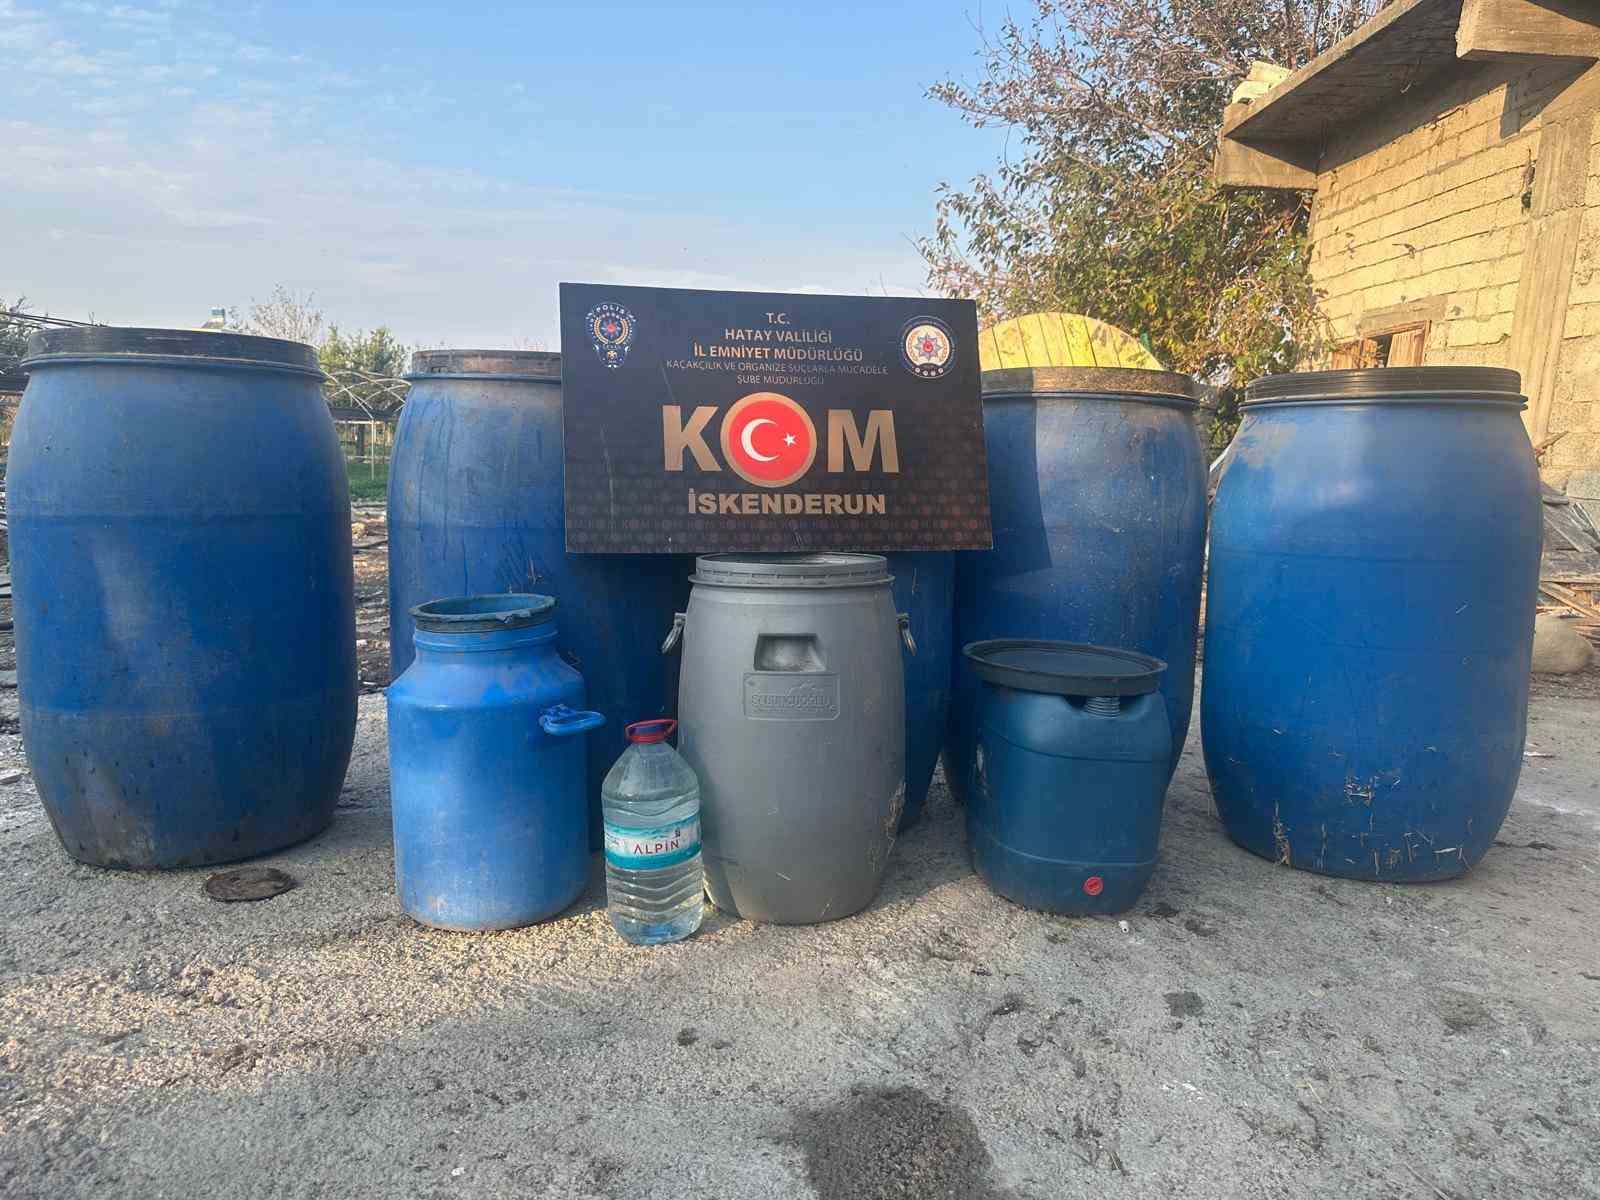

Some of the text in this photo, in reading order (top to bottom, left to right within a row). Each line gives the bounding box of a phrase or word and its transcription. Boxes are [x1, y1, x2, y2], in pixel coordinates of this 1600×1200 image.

[766, 312, 790, 324] T.C.
[725, 328, 772, 341] HATAY
[694, 342, 706, 357] İL
[710, 344, 770, 359] EMNİYET
[724, 361, 736, 370] VE
[662, 391, 899, 488] KOM
[687, 487, 887, 515] İSKENDERUN
